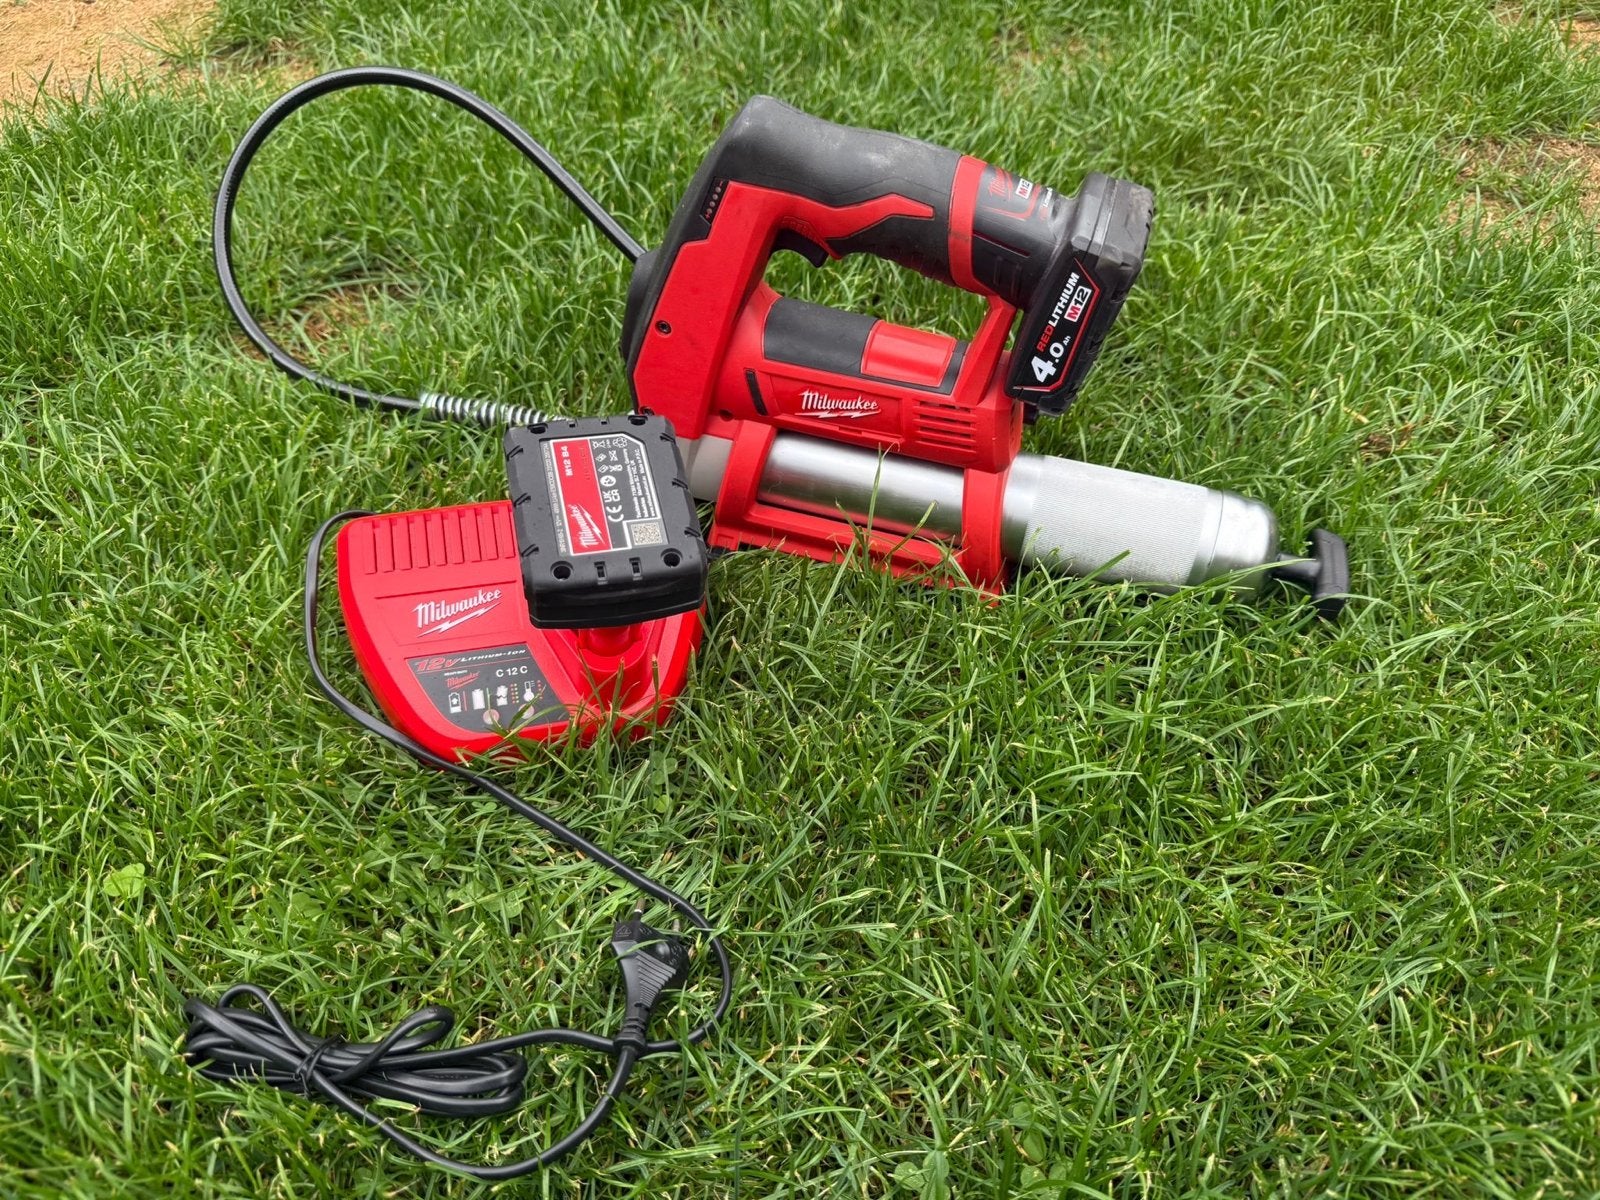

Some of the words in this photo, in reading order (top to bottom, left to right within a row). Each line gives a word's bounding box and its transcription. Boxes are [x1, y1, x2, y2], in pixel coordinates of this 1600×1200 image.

[1017, 179, 1032, 198] M12
[1065, 287, 1090, 321] M12
[1031, 342, 1064, 383] 4.0
[798, 388, 879, 411] Milwaukee
[563, 459, 574, 477] M12
[411, 588, 503, 629] Milwaukee
[495, 669, 504, 678] C
[506, 667, 518, 676] 12
[520, 665, 529, 674] C
